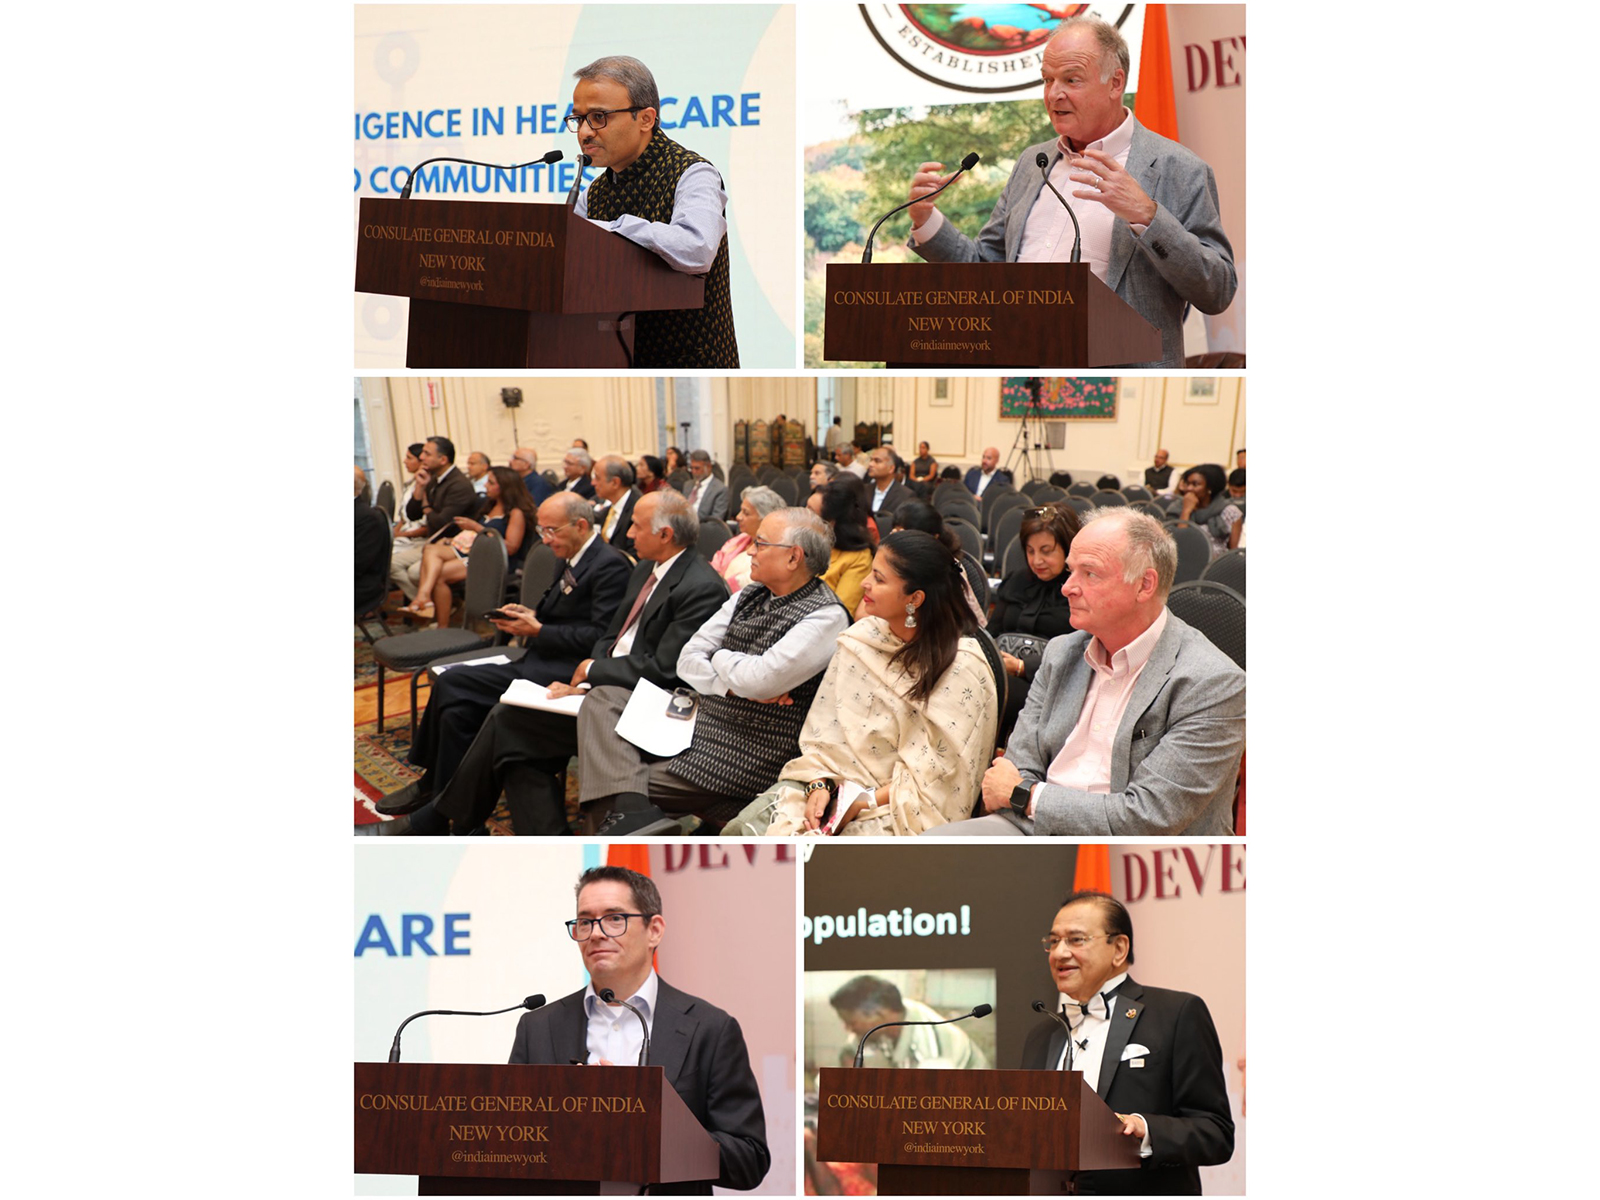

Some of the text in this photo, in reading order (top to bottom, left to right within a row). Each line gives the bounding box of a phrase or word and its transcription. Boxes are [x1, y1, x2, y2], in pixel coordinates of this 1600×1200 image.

[1183, 35, 1246, 94] DE
[472, 106, 504, 137] IN
[364, 225, 554, 247] CONSULATE GENERAL OF INDIA
[420, 254, 485, 271] NEW YORK
[420, 276, 483, 292] @indiainnewyork
[834, 291, 1074, 305] CONSULATE GENERAL OF INDIA
[909, 317, 991, 331] NEW YORK
[911, 340, 991, 353] @indiainnewyork
[354, 913, 471, 957] ARE
[360, 1094, 646, 1112] CONSULATE GENERAL OF INDIA
[828, 1095, 1067, 1110] CONSULATE GENERAL OF INDIA
[450, 1126, 549, 1141] NEW YORK
[903, 1121, 985, 1135] NEW YORK
[904, 1143, 984, 1156] @indiainnewyork
[452, 1151, 547, 1166] @indiainnewyork
